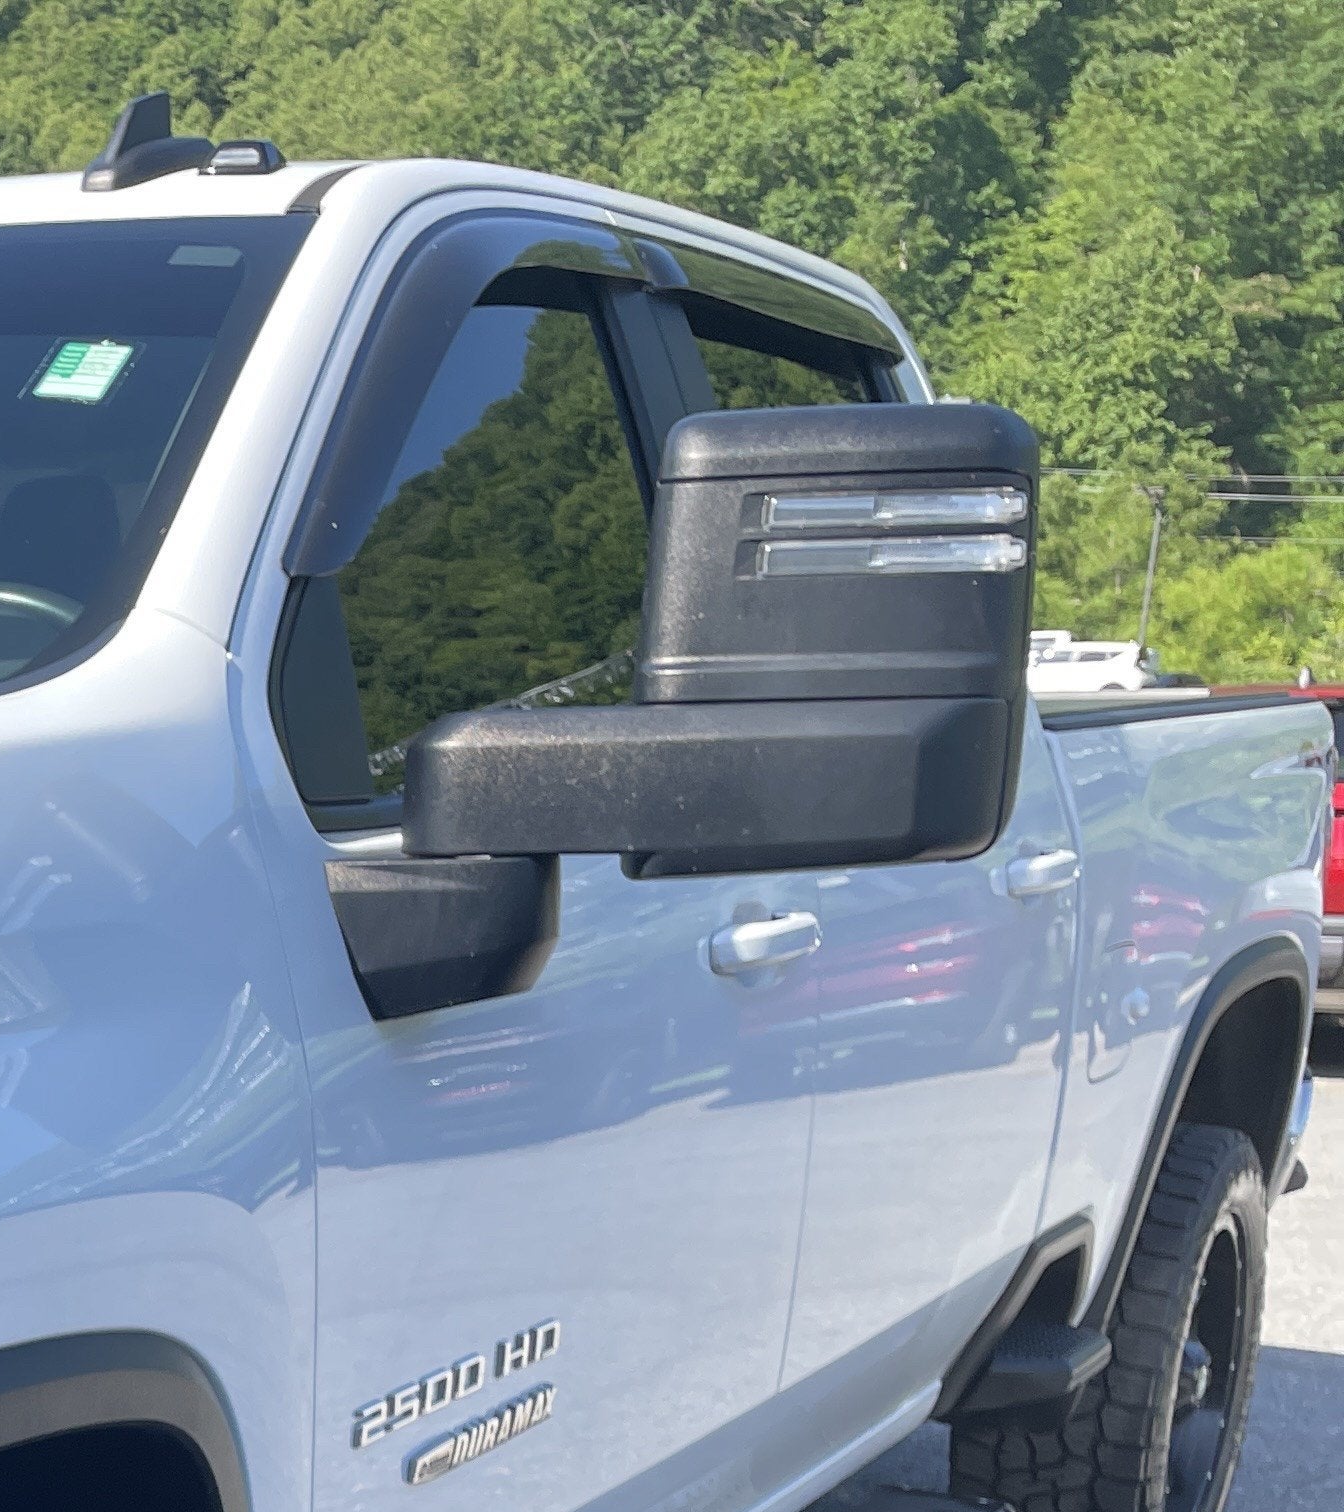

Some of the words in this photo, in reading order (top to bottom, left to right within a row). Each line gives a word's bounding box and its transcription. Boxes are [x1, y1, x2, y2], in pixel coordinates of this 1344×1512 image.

[350, 1350, 487, 1450] 2500
[494, 1317, 562, 1380] HD
[451, 1383, 558, 1471] DURAMAX
